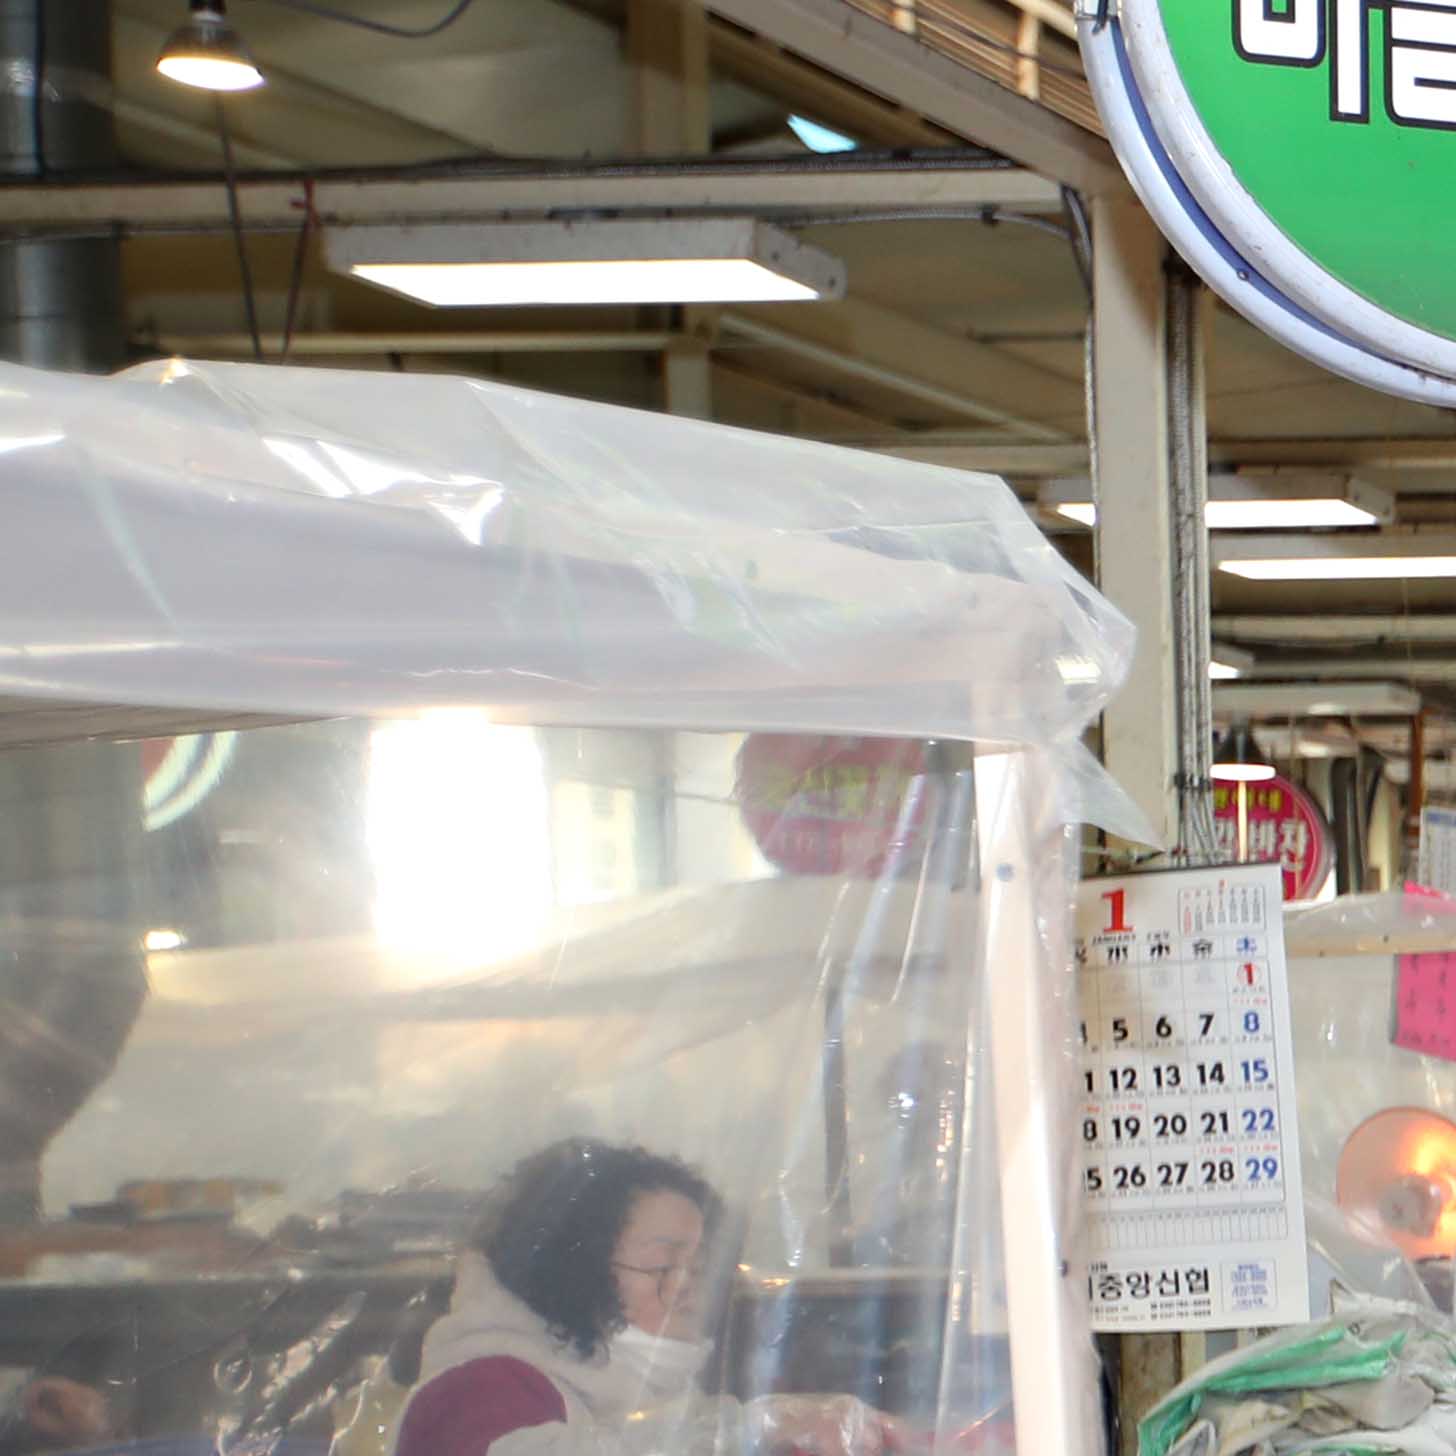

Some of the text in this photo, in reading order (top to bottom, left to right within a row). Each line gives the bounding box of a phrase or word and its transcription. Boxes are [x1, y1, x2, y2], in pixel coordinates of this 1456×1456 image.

[1102, 888, 1133, 933] 1
[1112, 1011, 1260, 1041] 5 6 7 8
[1110, 1067, 1138, 1092] 12
[1153, 1065, 1181, 1089] 13
[1197, 1062, 1225, 1086] 14
[1240, 1060, 1269, 1083] 15
[1112, 1117, 1141, 1140] 19
[1153, 1114, 1187, 1138] 20
[1200, 1112, 1229, 1135] 21
[1242, 1108, 1275, 1132] 22
[1083, 1158, 1278, 1192] 5 26 27 28 29
[1088, 1266, 1211, 1302] 중앙신협
